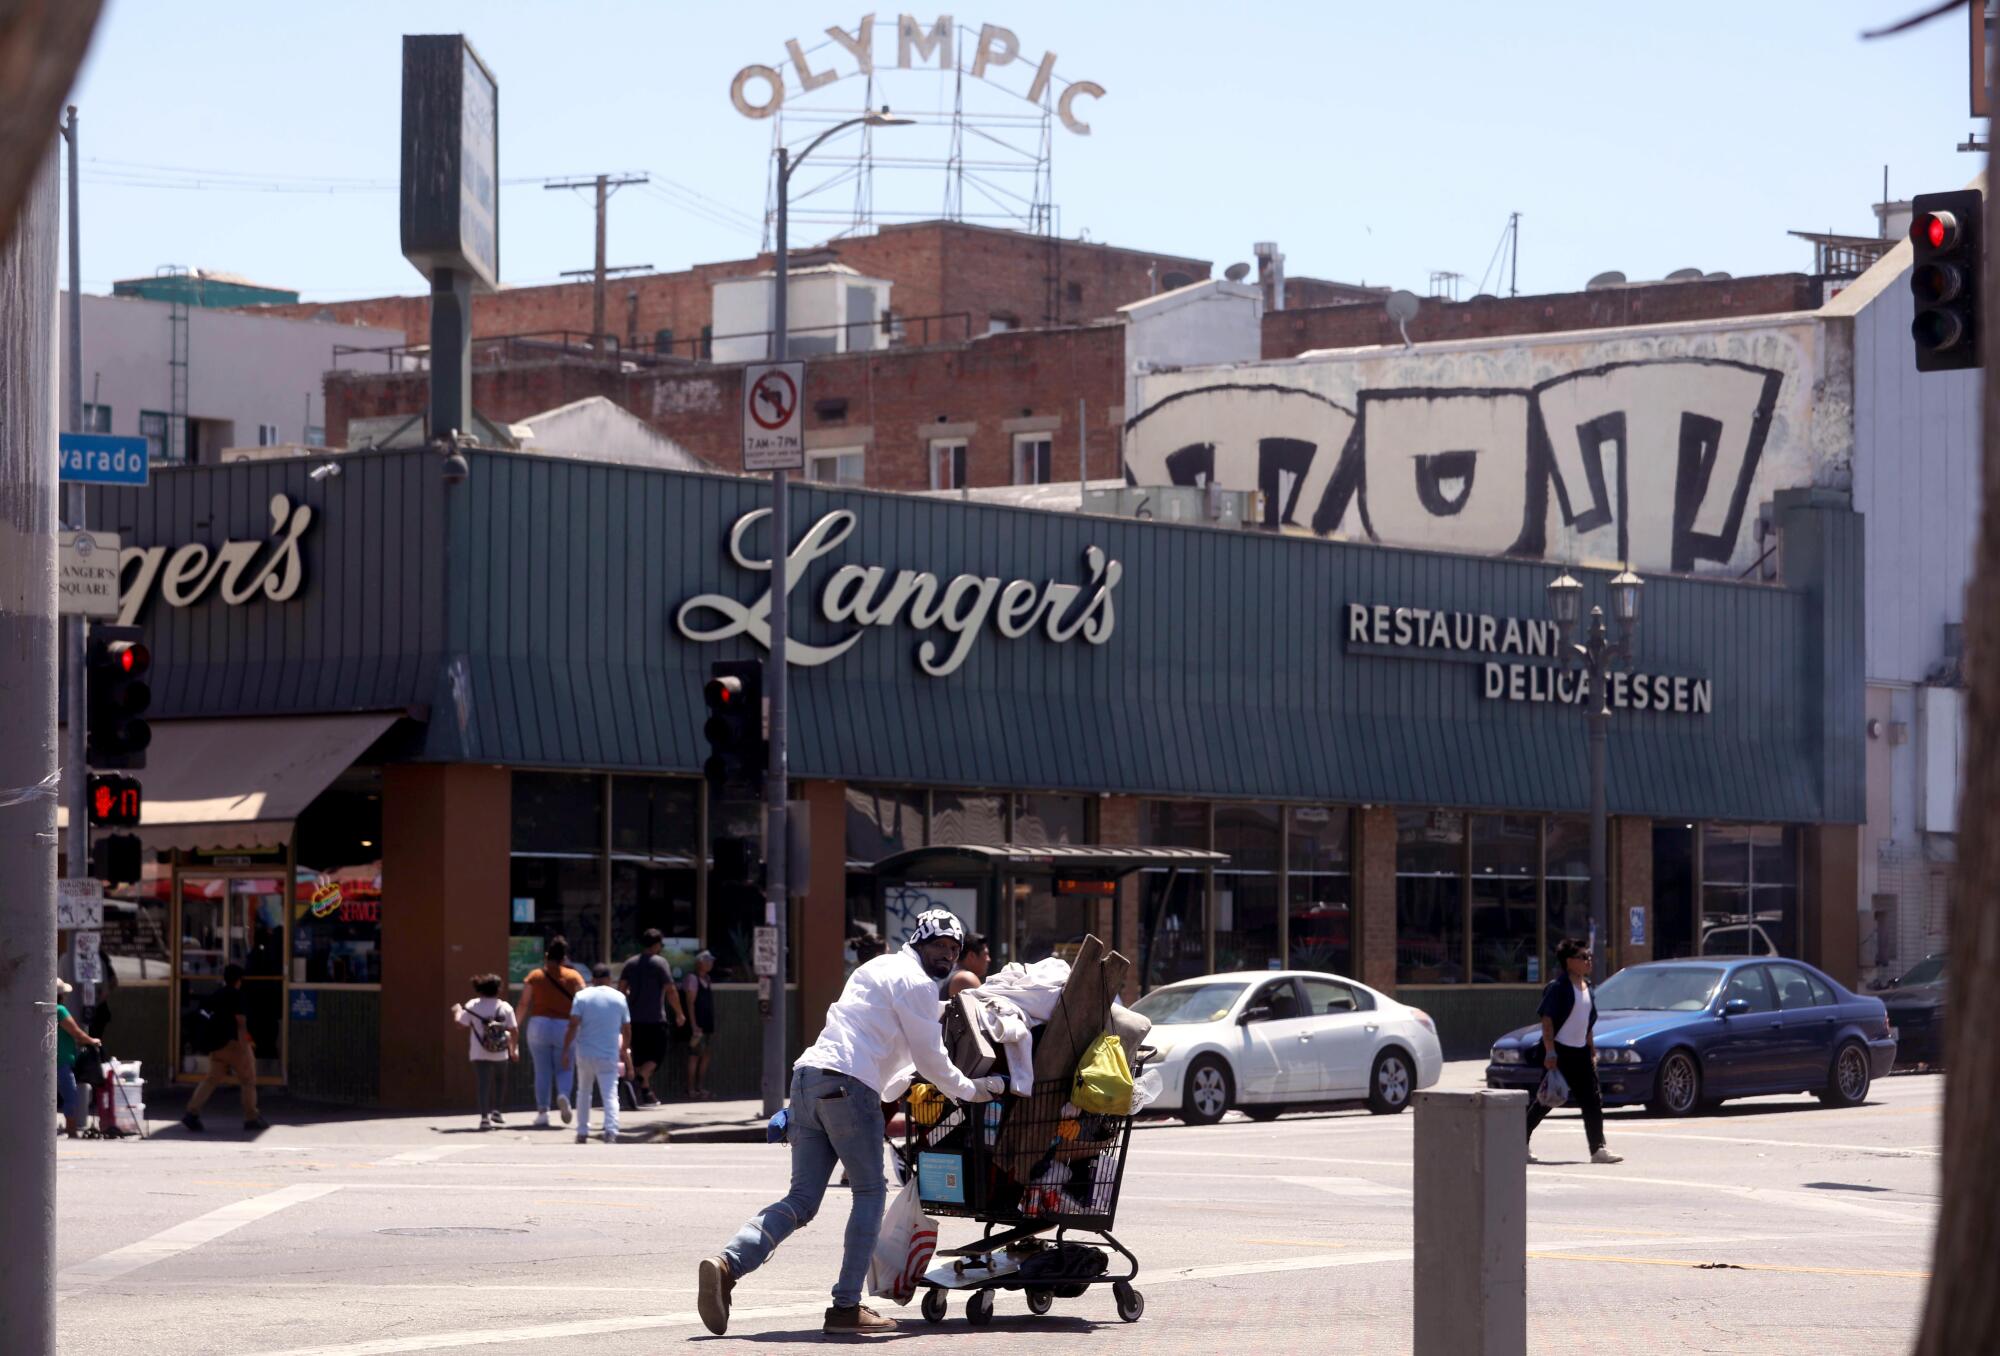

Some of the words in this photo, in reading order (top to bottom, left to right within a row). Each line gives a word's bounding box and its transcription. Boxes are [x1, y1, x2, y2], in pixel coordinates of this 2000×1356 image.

[730, 13, 1107, 135] OLYMPIC
[59, 565, 116, 579] ANGER'S
[677, 508, 1122, 677] Langer's
[1485, 662, 1712, 714] DELICAESSEN
